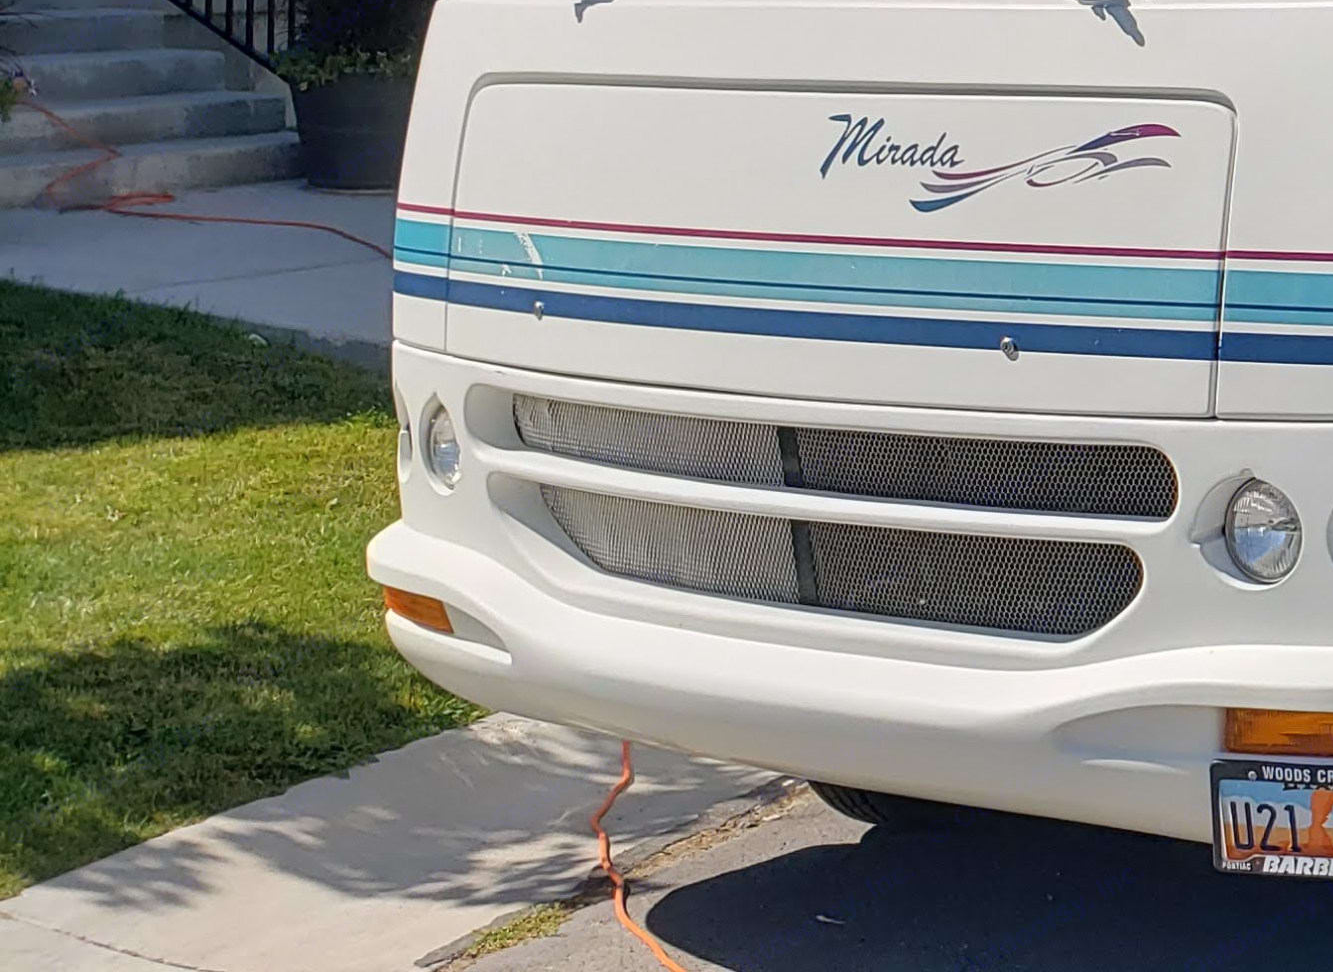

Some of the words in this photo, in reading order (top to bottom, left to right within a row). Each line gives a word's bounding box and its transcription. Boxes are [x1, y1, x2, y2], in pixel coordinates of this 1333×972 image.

[820, 113, 964, 179] Mirada
[1261, 765, 1311, 782] WOODS
[1230, 801, 1301, 852] U21
